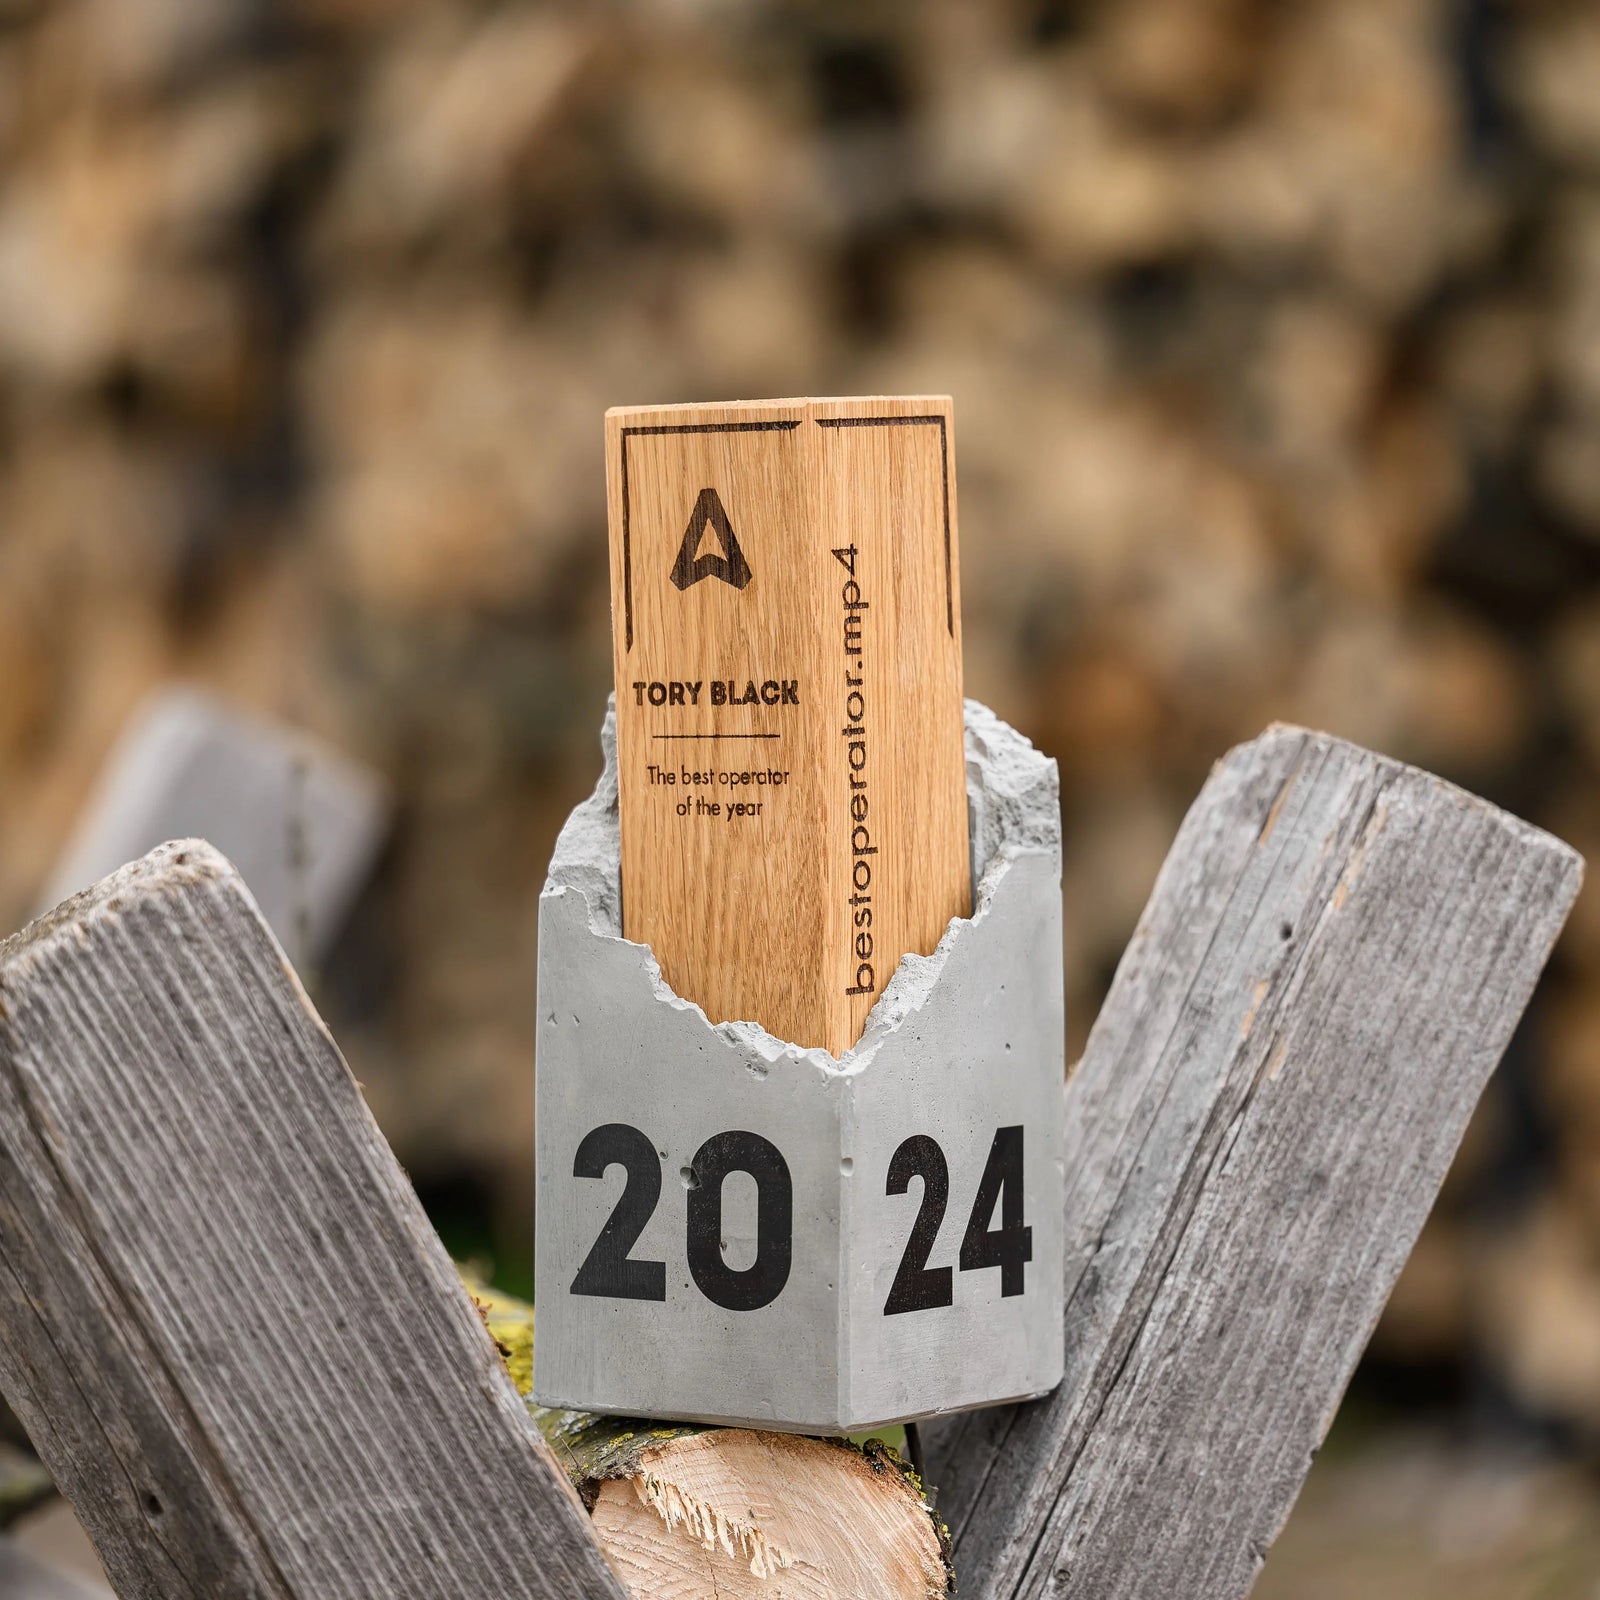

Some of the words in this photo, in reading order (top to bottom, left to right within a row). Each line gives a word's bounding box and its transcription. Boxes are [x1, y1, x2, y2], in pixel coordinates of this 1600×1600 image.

[632, 680, 703, 706] TORY
[710, 679, 800, 706] BLACK
[647, 765, 676, 786] The
[681, 764, 715, 786] best
[718, 767, 790, 791] operator
[831, 543, 878, 996] bestoperator.mp4
[676, 795, 692, 816] of
[696, 795, 721, 816] the
[726, 802, 763, 822] year
